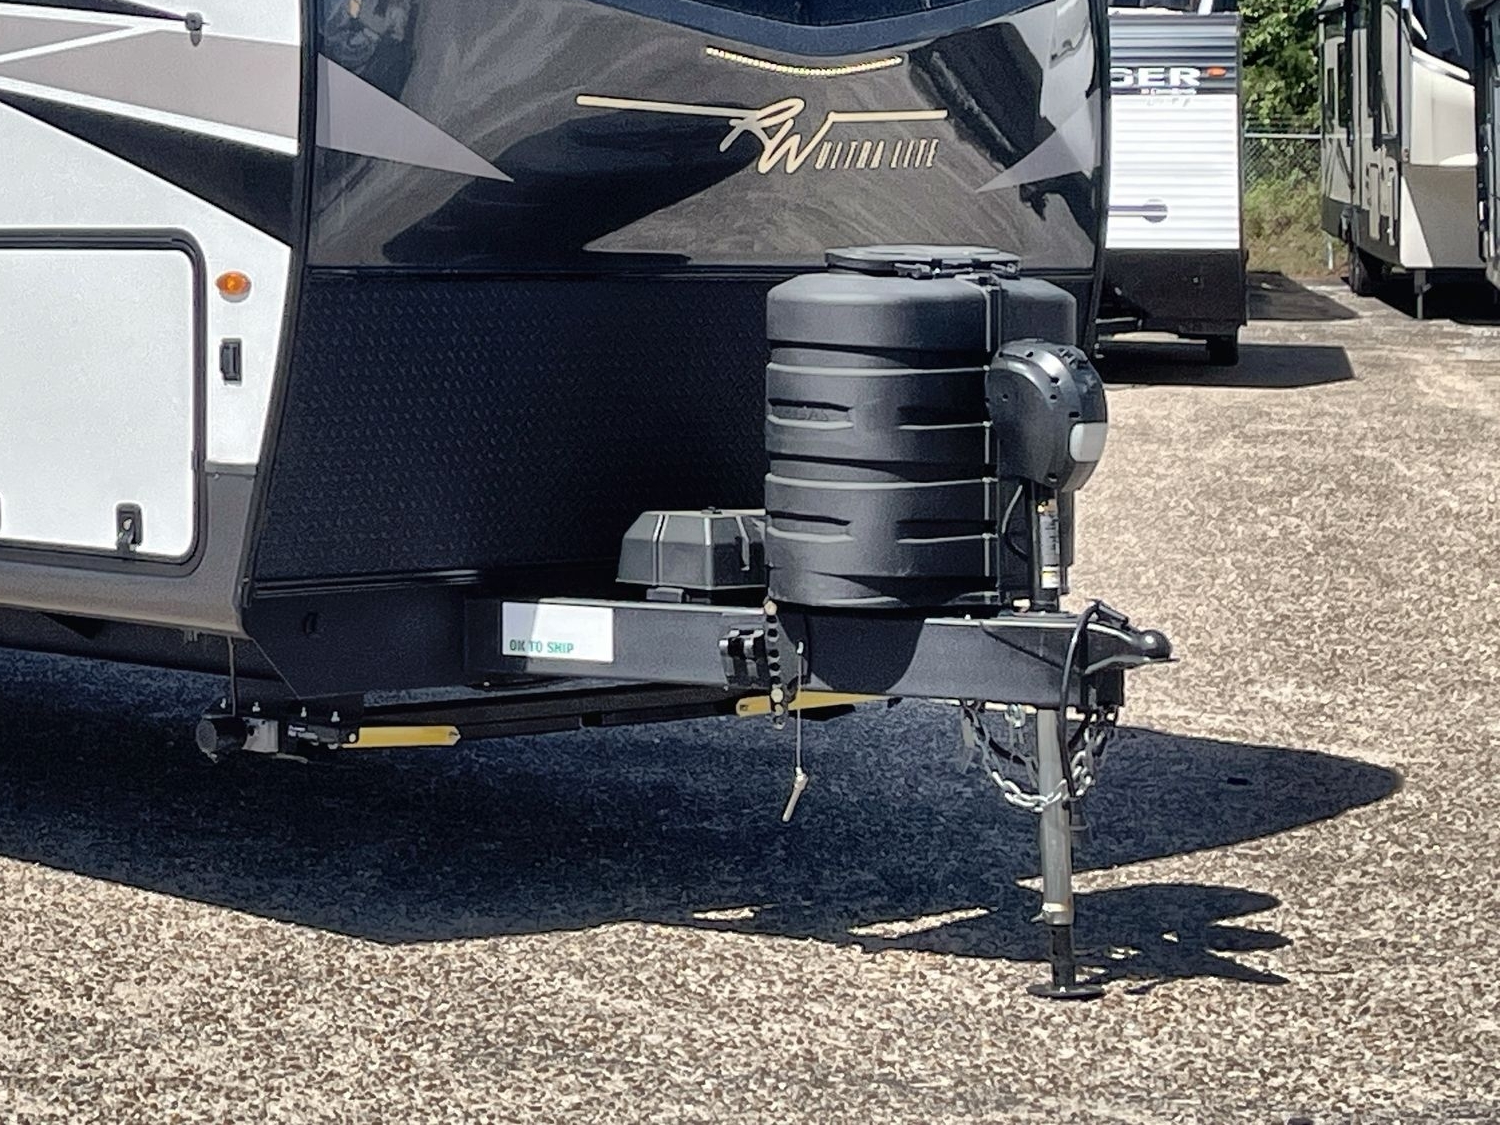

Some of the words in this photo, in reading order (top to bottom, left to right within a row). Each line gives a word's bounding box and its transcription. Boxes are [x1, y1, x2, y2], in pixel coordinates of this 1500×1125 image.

[814, 140, 885, 170] ULTRA
[890, 138, 939, 169] LITE
[509, 639, 526, 652] OK
[528, 641, 543, 653] TO
[546, 642, 575, 654] SHIP
